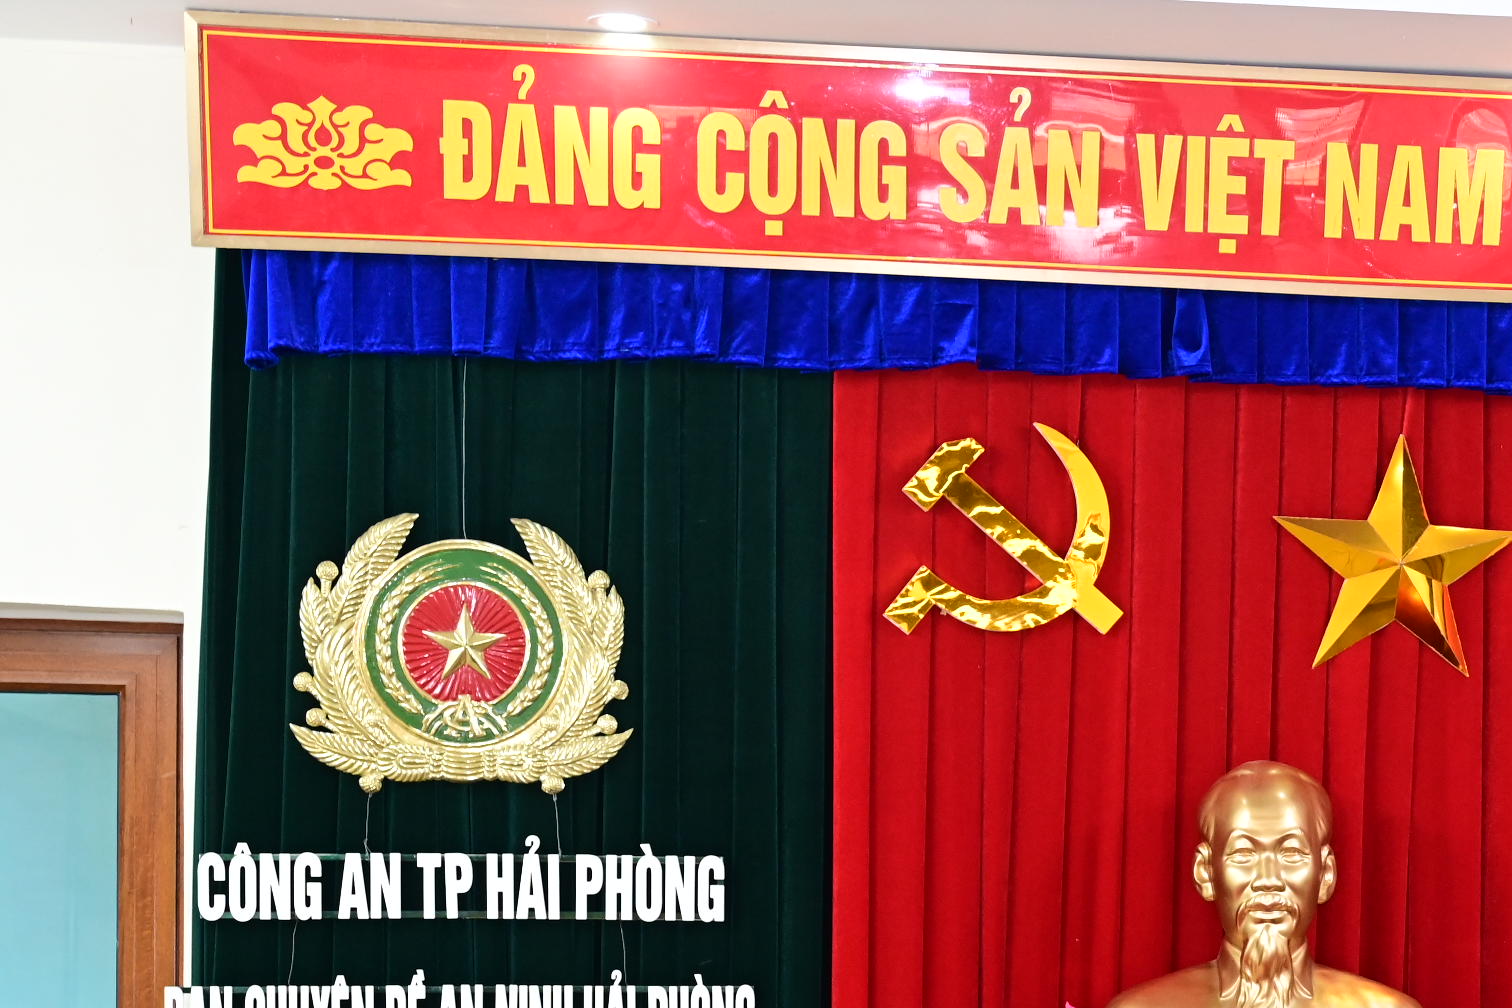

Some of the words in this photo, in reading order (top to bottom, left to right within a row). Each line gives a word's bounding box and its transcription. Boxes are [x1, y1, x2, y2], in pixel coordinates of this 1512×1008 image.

[439, 64, 661, 210] ĐẢNG
[697, 90, 907, 236] CỘNG
[938, 87, 1101, 229] SẢN
[1136, 114, 1297, 254] VIỆT
[1324, 141, 1506, 247] NAM
[197, 842, 322, 921] CÔNG
[337, 852, 402, 920] AN
[416, 852, 473, 920] TP
[486, 834, 561, 920] HẢI
[575, 843, 725, 923] PHÒNG
